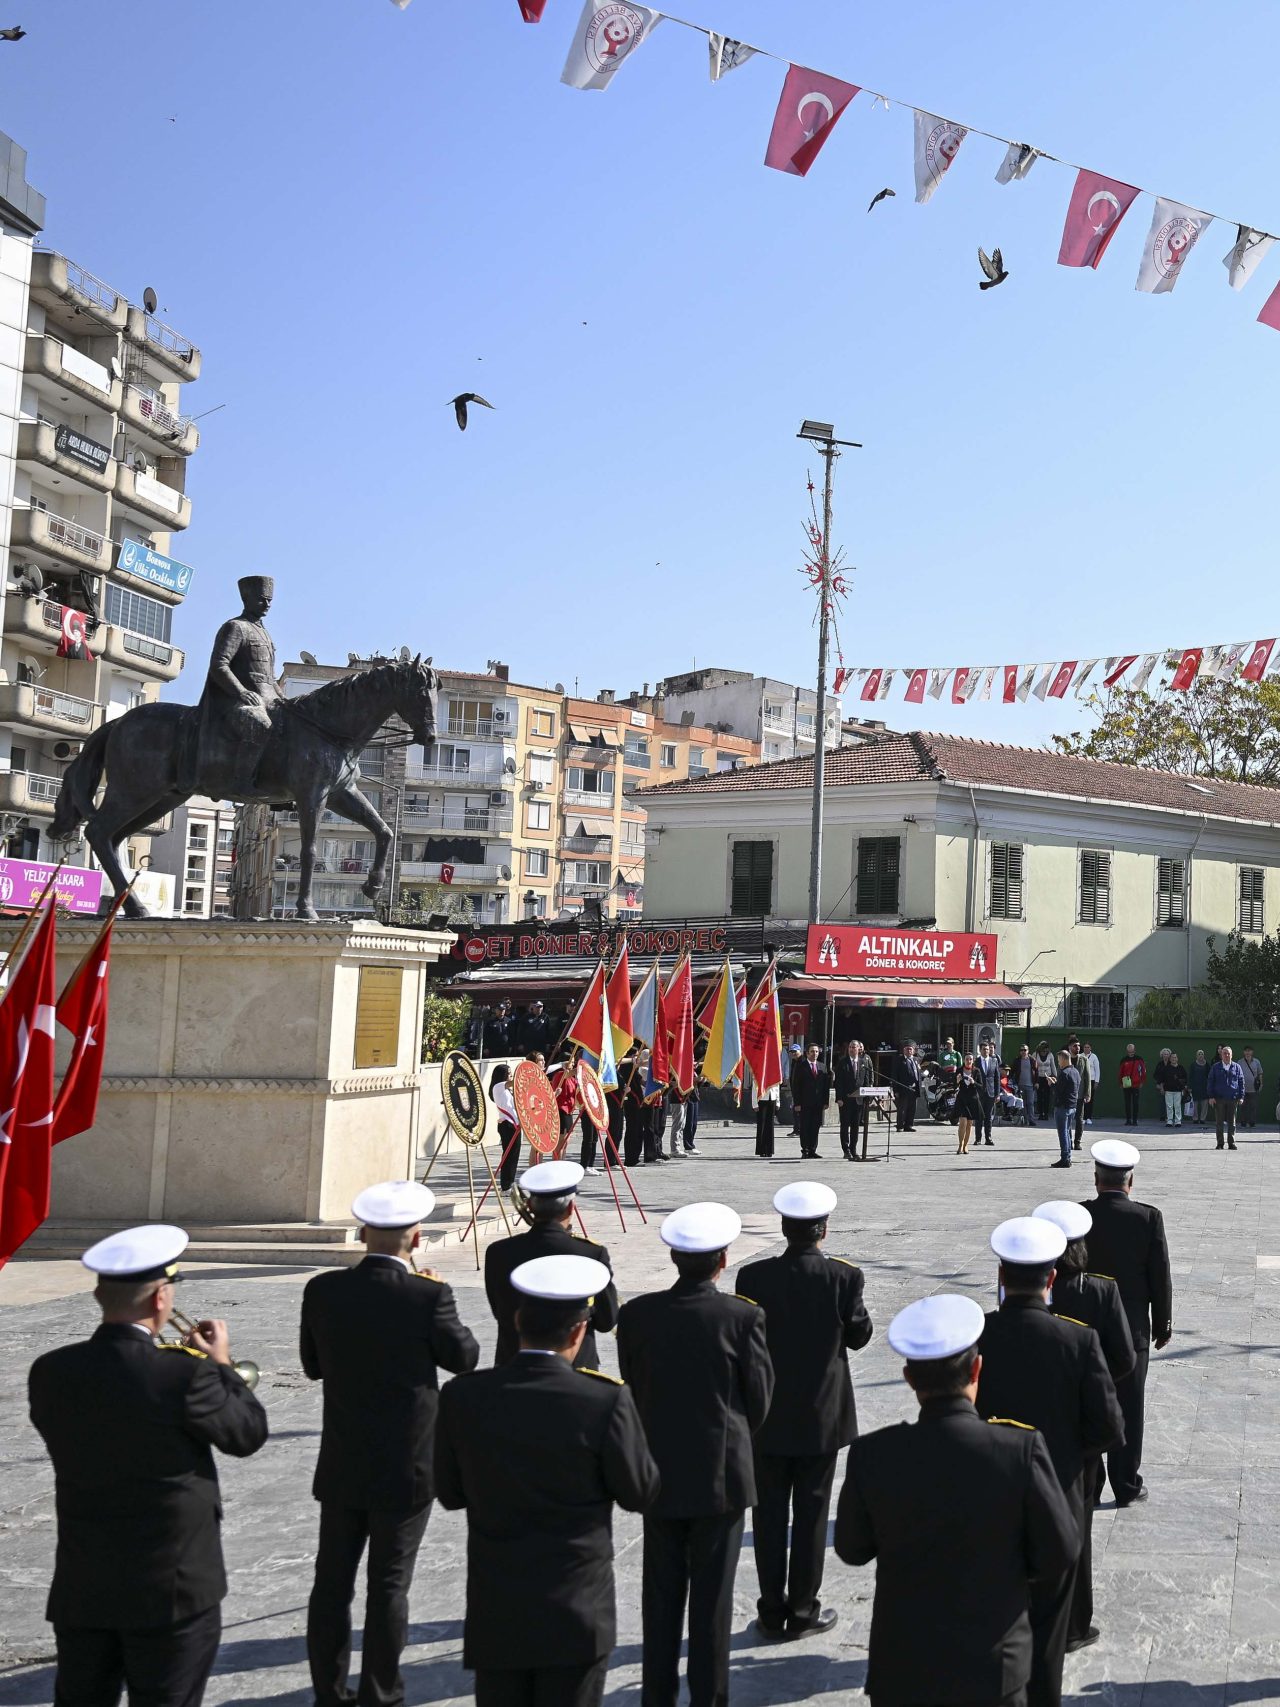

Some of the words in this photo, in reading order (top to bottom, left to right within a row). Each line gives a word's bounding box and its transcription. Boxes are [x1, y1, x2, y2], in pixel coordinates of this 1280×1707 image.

[23, 868, 47, 883] YELİZ
[519, 930, 593, 957] DÖNER
[857, 935, 954, 958] ALTINKALP
[865, 955, 897, 969] DÖNER
[898, 961, 905, 969] &
[905, 961, 946, 972] KOKOREÇ
